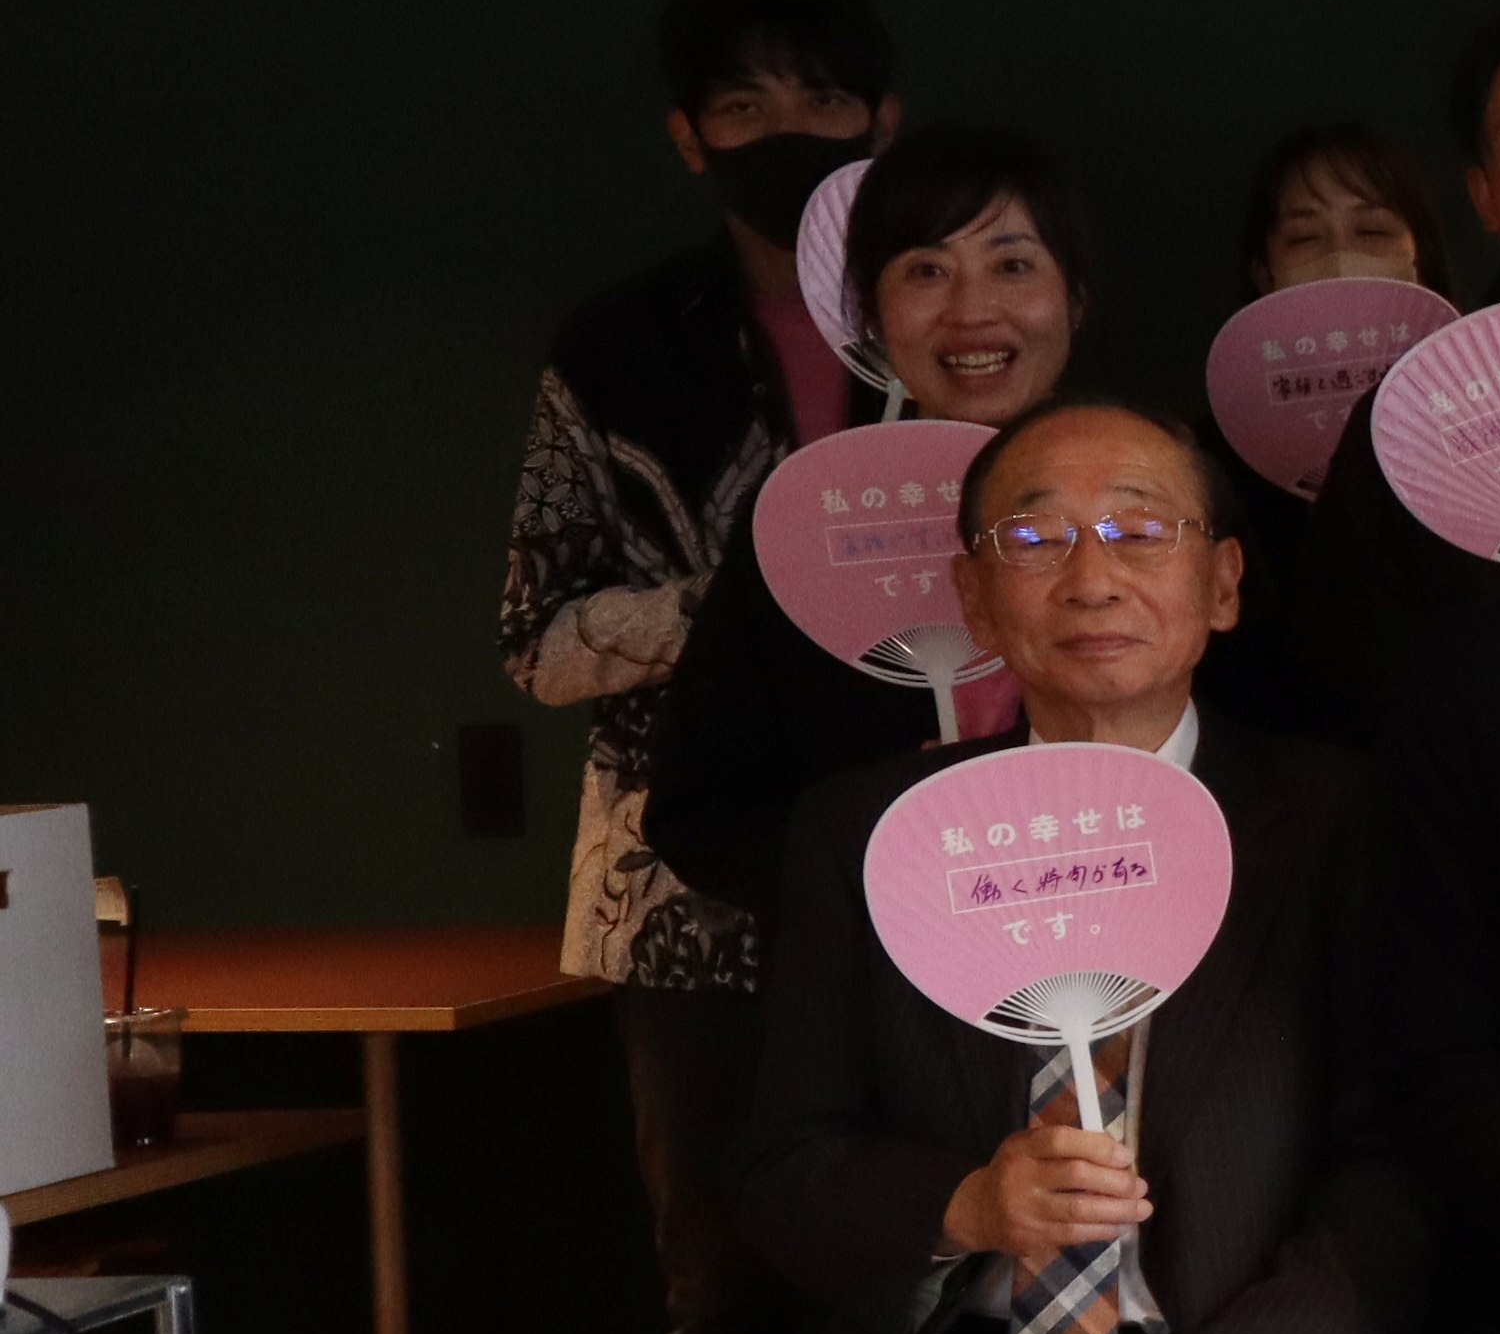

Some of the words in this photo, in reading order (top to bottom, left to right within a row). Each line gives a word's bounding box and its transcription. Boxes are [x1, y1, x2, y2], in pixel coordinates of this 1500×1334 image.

[820, 480, 963, 514] 私の幸せ
[940, 802, 1147, 857] 私の幸せは
[1002, 912, 1101, 946] です。
